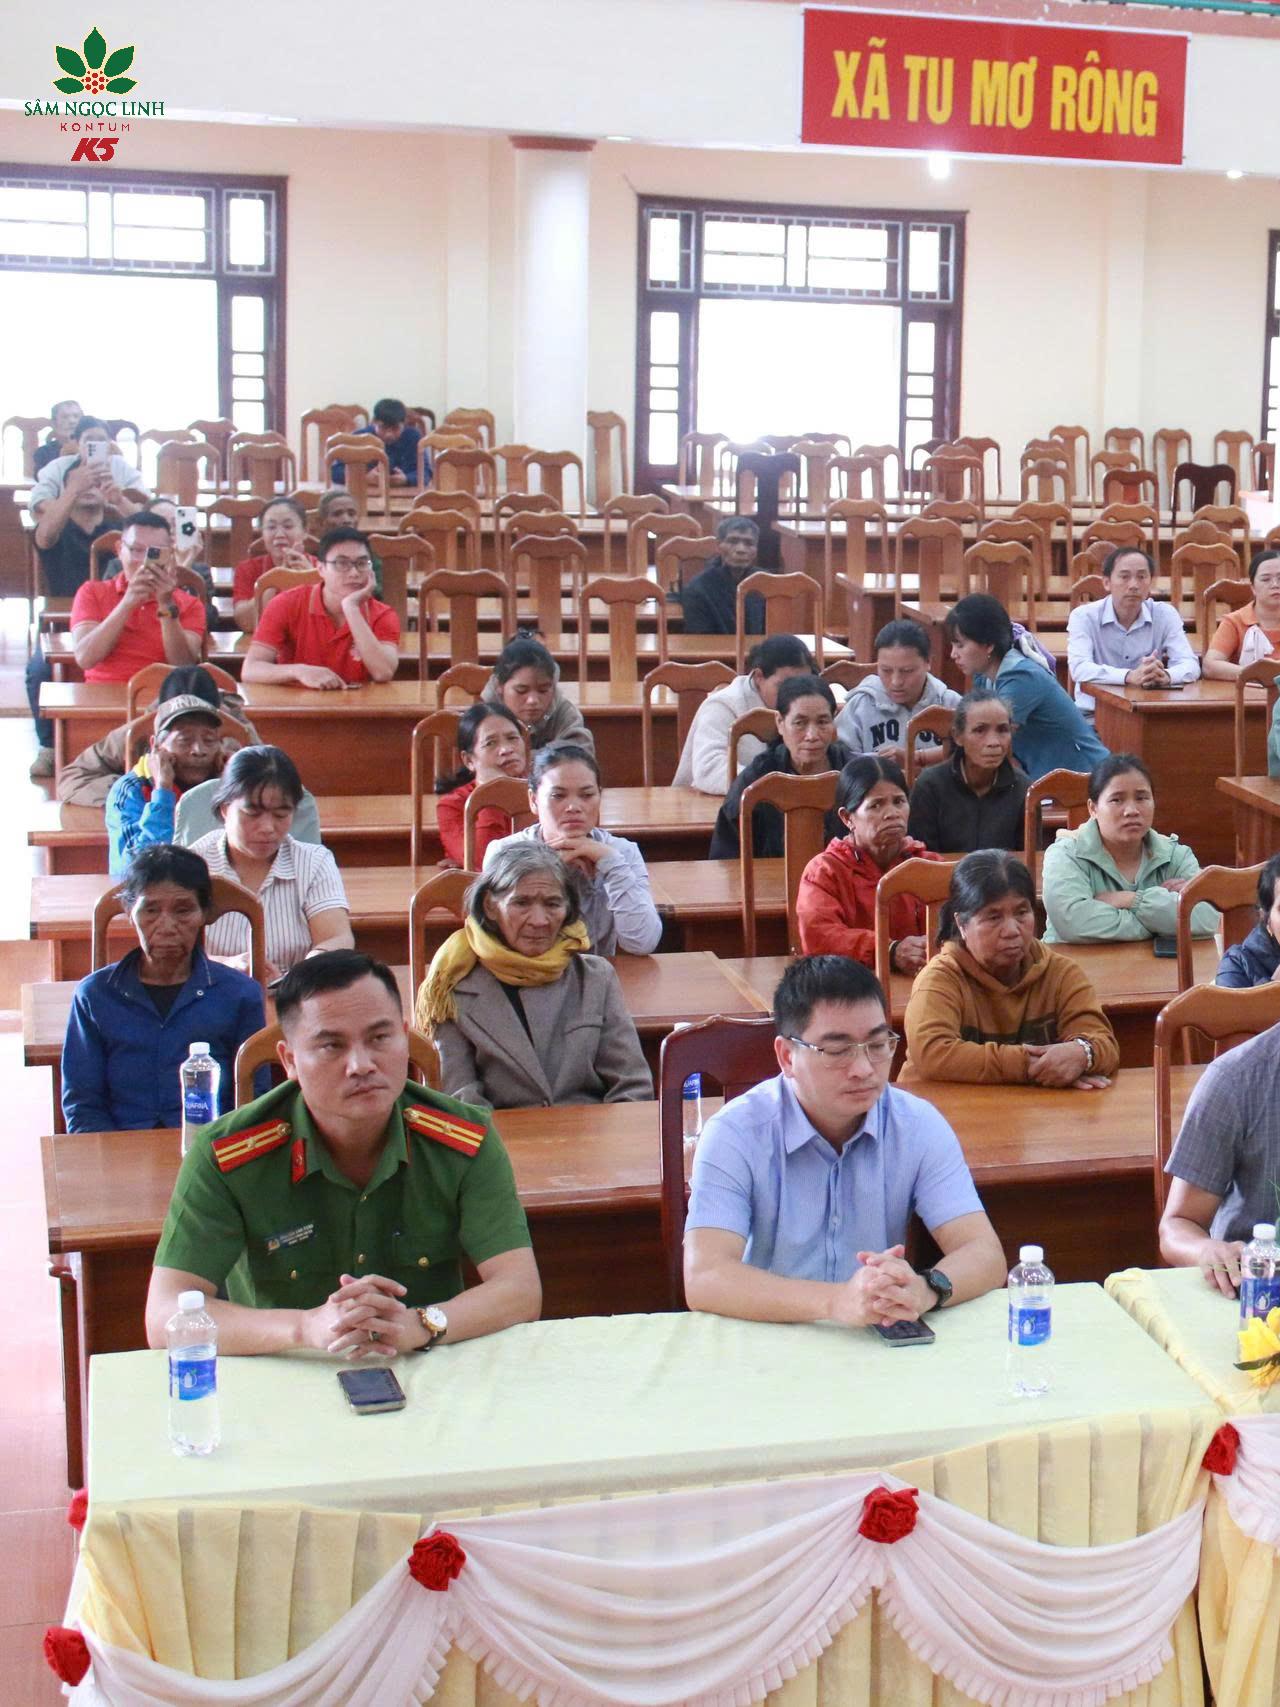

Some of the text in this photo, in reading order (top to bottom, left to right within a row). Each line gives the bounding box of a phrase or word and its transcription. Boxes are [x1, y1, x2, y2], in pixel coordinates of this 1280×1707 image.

[831, 36, 1158, 137] XÃ TU MƠ RÔNG
